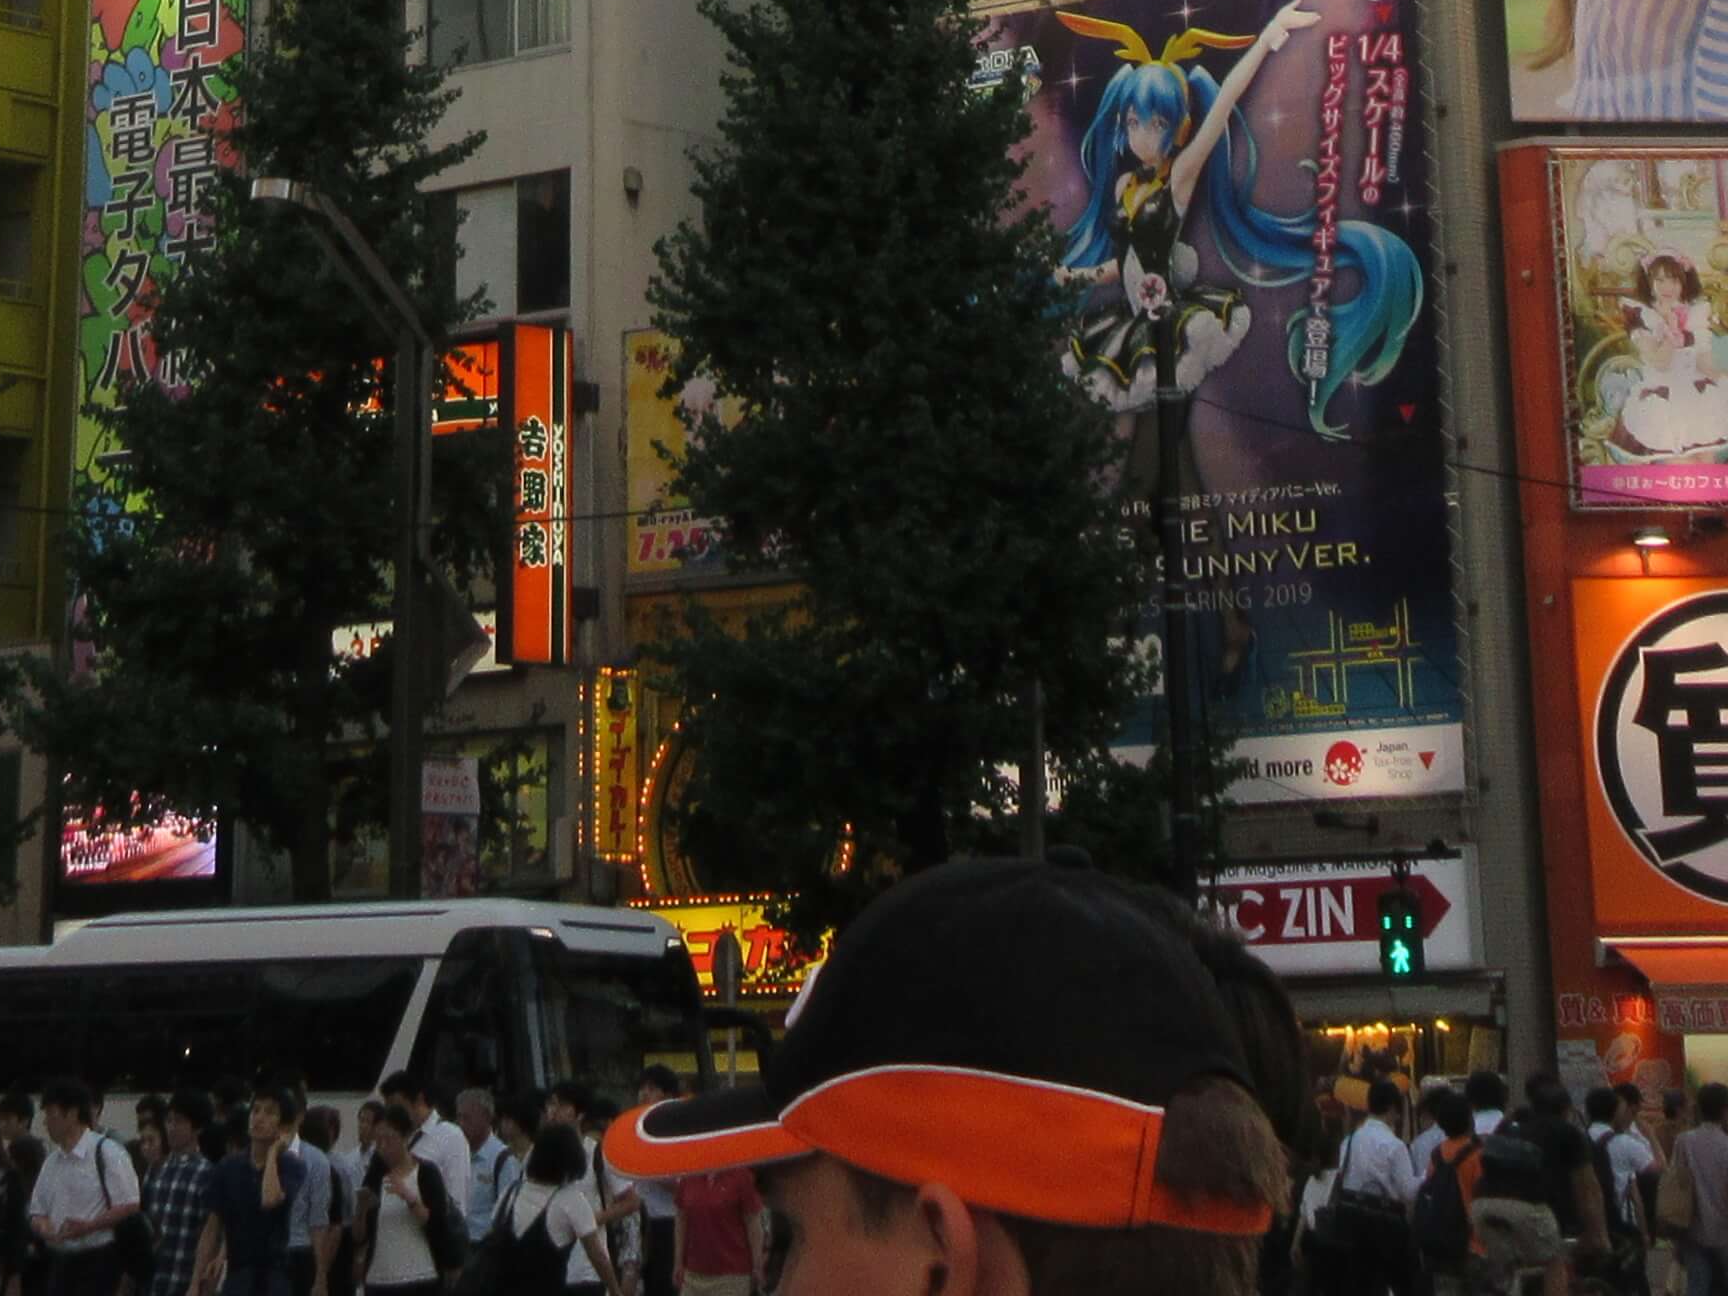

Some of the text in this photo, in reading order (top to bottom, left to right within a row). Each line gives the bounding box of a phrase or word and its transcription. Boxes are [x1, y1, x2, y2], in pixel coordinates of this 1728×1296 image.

[520, 416, 548, 568] 吉野家
[1226, 508, 1318, 540] MIKU
[1285, 541, 1372, 571] VER.
[1262, 582, 1314, 609] 2019
[1265, 755, 1314, 783] more
[1279, 886, 1355, 938] ZIN
